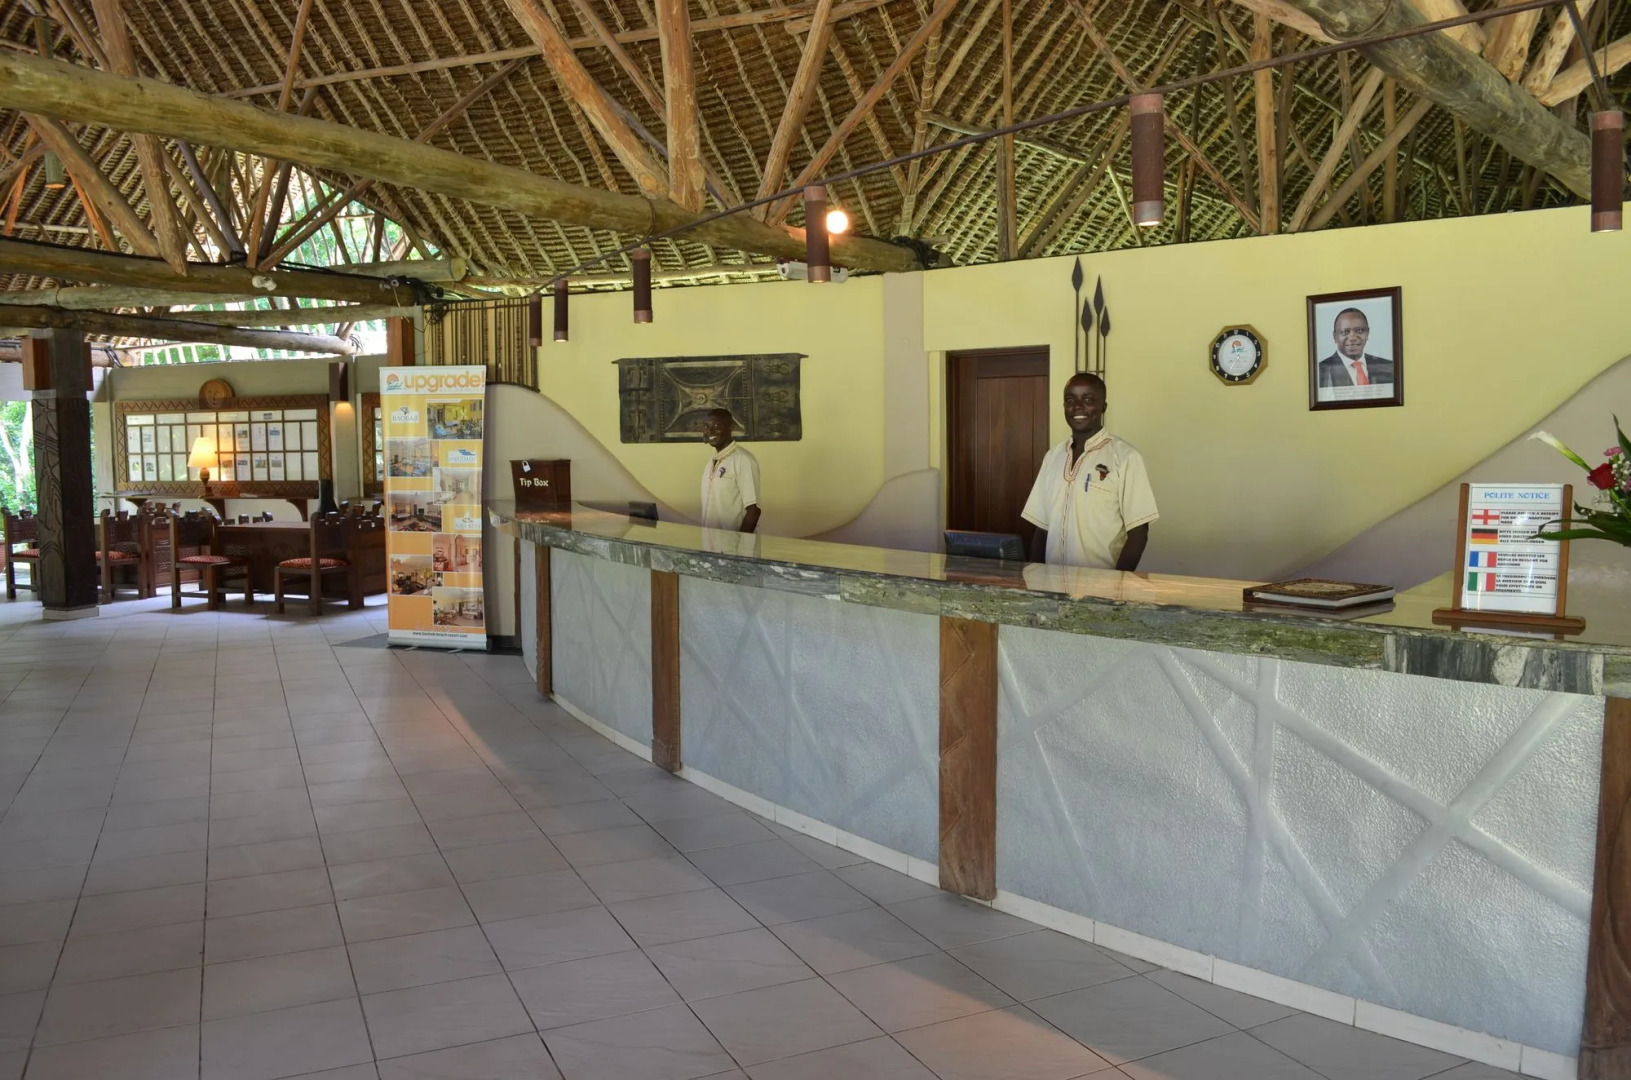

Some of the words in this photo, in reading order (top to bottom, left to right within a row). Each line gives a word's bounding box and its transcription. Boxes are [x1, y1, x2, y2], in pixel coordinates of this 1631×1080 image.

[404, 370, 485, 392] upgrade!
[519, 477, 532, 488] Tip
[533, 477, 549, 487] Box
